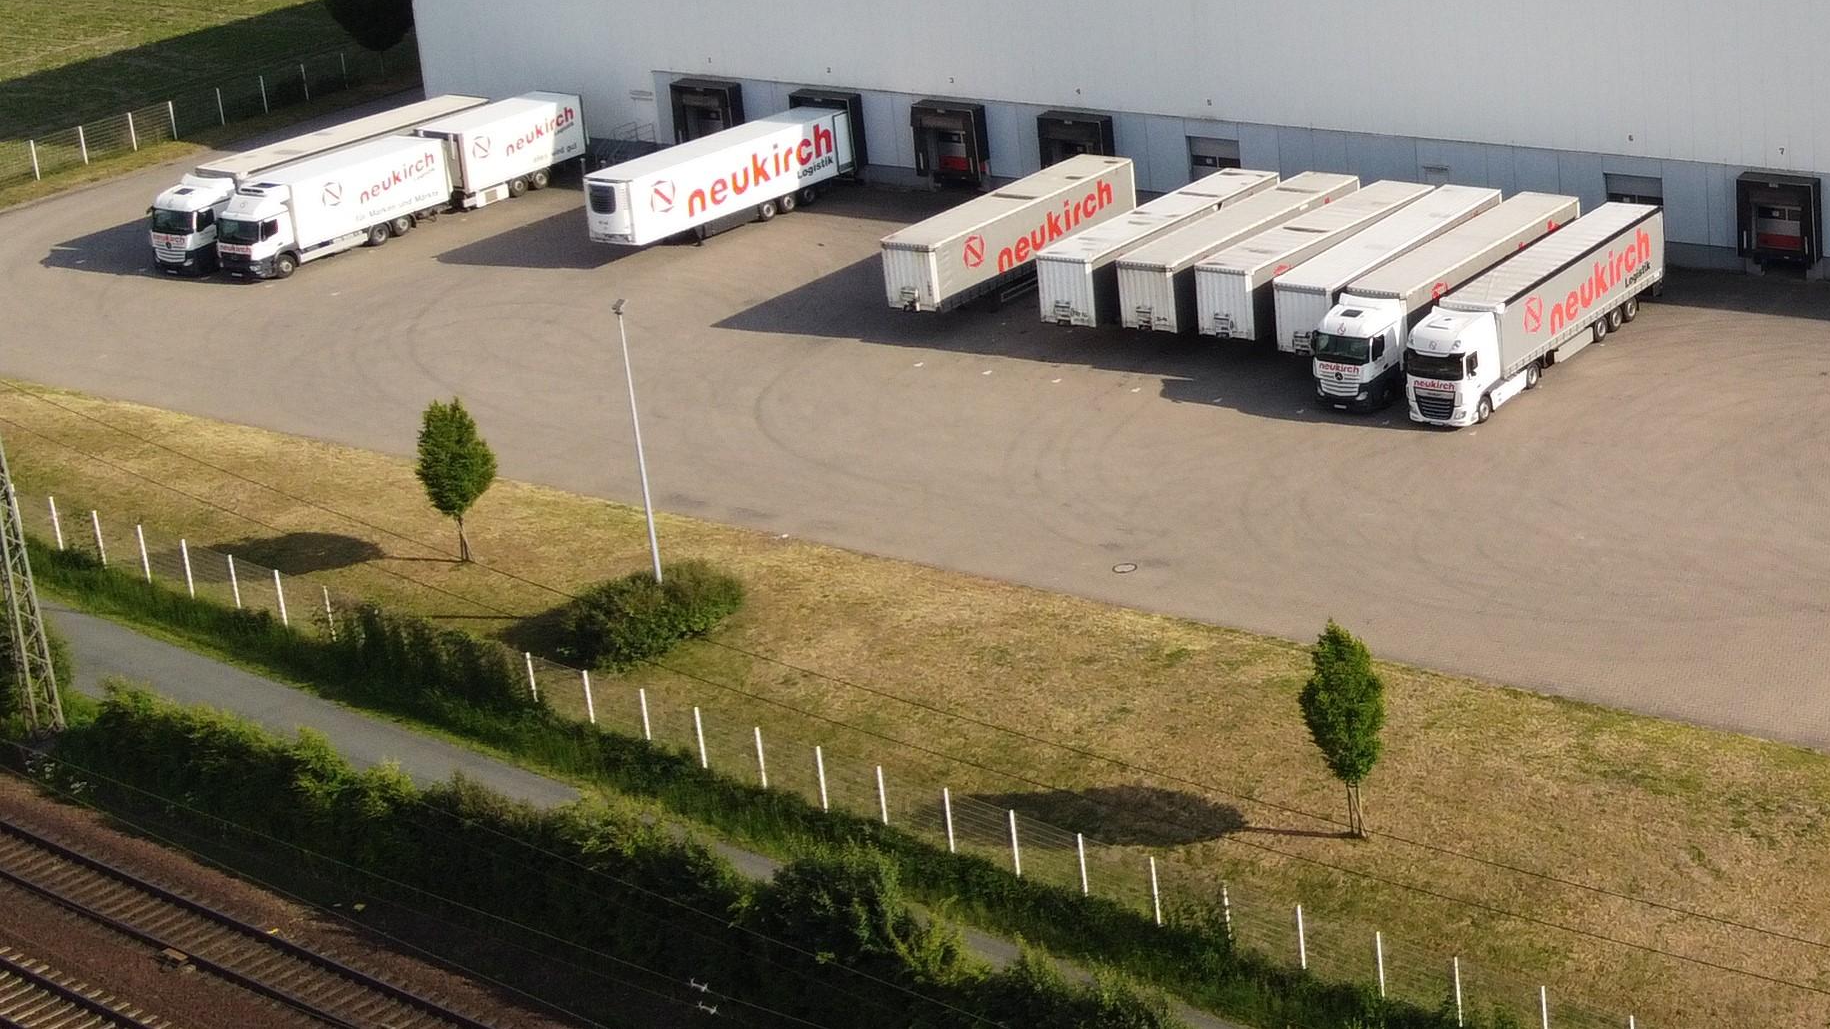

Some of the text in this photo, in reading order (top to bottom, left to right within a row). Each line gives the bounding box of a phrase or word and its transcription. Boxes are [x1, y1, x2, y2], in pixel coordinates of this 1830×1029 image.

[506, 107, 574, 156] neukirch
[360, 152, 435, 204] neukirch
[688, 123, 833, 217] neukirch
[796, 155, 834, 180] Logistik
[997, 179, 1113, 275] neukirch
[1550, 228, 1650, 336] neukirch
[1624, 261, 1651, 289] Logistik
[1319, 362, 1360, 374] neukirch
[1413, 378, 1456, 391] neukirch
